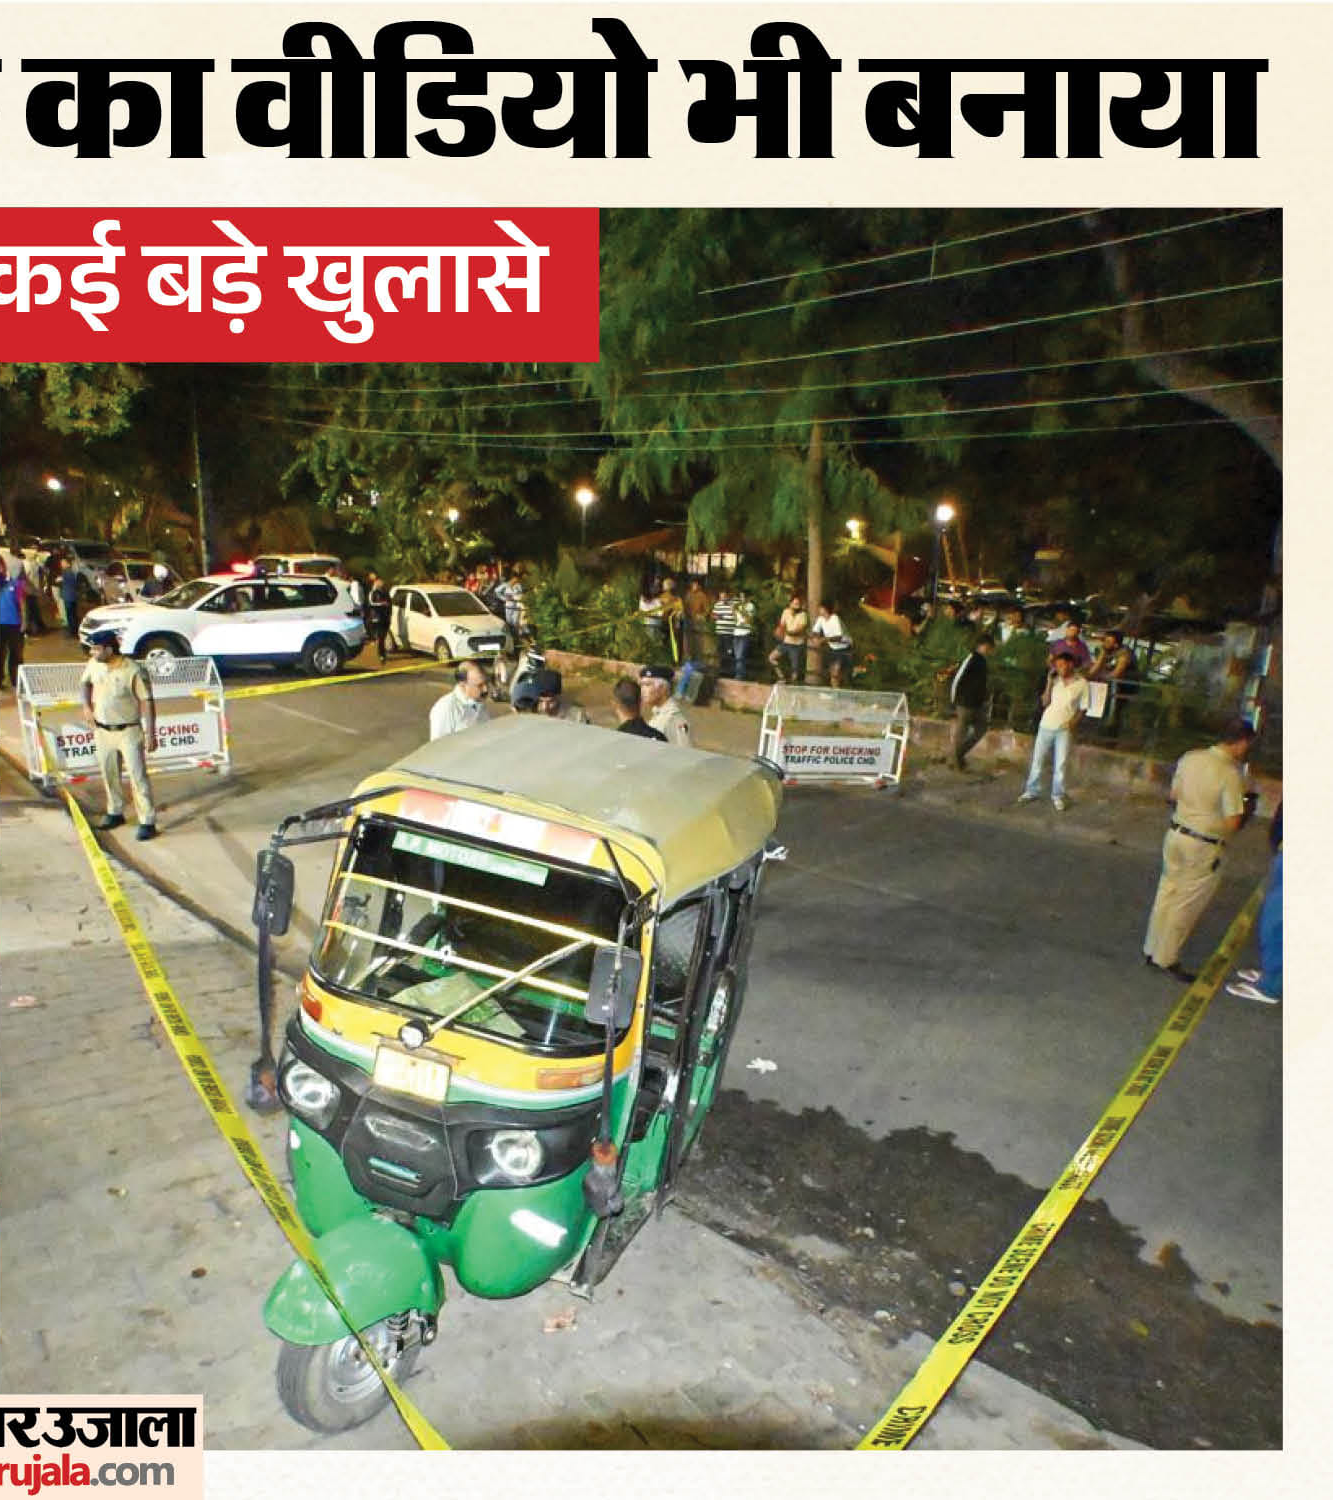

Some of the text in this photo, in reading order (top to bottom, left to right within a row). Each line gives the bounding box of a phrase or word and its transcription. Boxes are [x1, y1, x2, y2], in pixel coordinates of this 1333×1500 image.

[56, 723, 201, 749] STOP ECKING
[64, 745, 98, 759] TRAF
[947, 1310, 995, 1344] CROSS
[871, 1405, 928, 1447] CRIME
